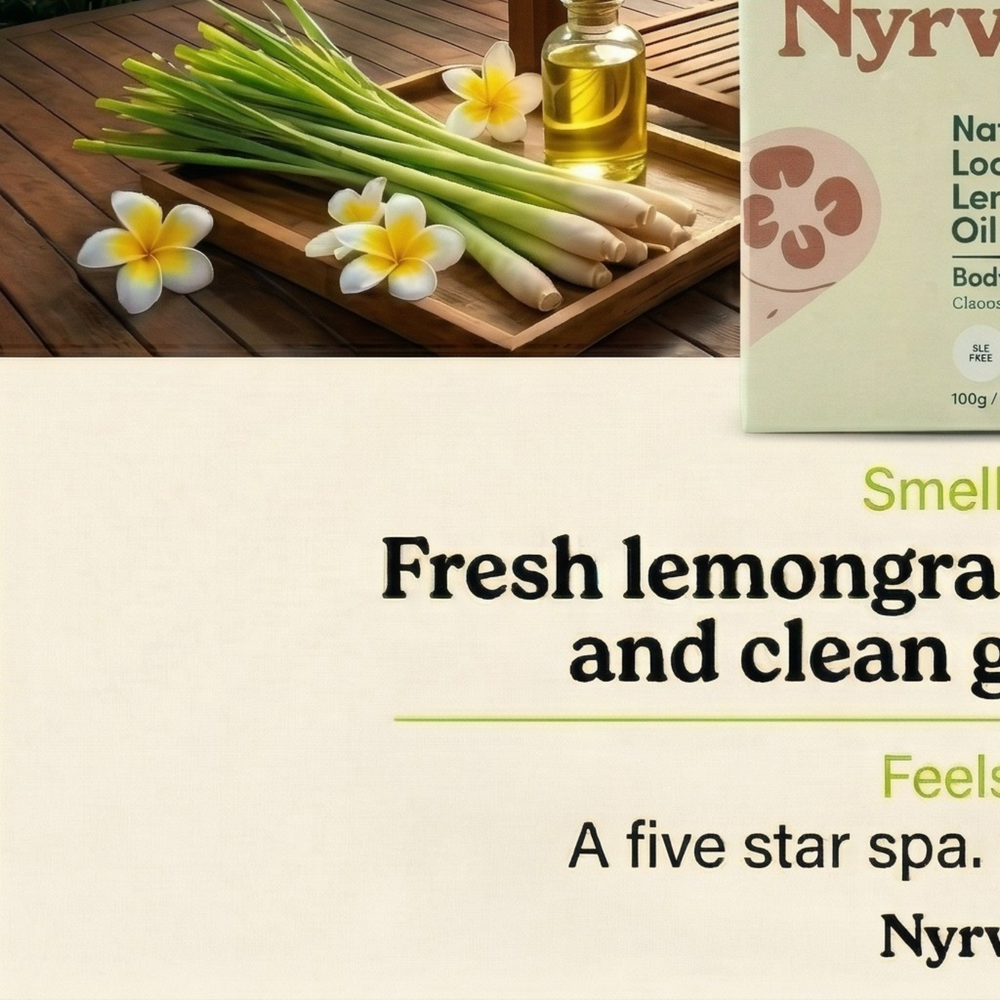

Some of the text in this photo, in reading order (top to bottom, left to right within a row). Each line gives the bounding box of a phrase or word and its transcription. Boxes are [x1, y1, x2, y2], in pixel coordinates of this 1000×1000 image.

[951, 216, 996, 243] Oil
[972, 344, 990, 353] SLE
[951, 392, 987, 409] 100g
[991, 392, 998, 405] /
